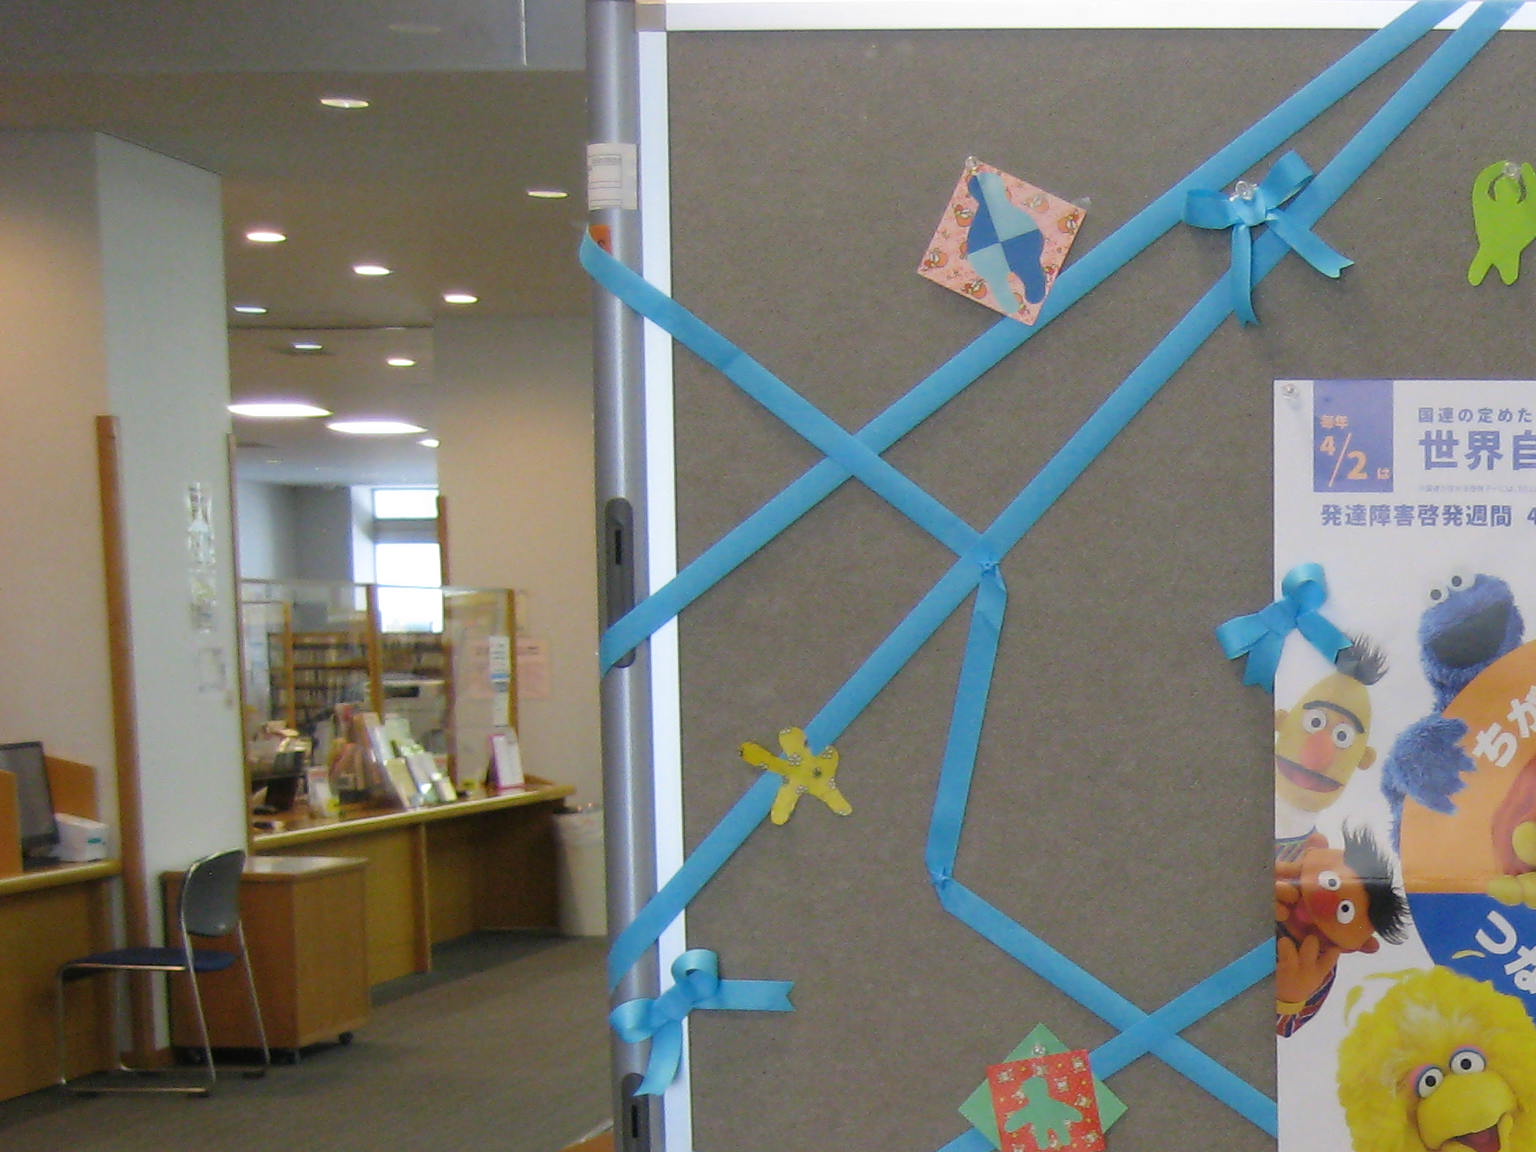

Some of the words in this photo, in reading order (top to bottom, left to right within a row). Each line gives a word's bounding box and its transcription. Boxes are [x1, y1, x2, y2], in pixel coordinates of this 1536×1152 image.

[1418, 407, 1534, 424] 国連の定めた
[1321, 504, 1512, 527] 発達障害啓発週間
